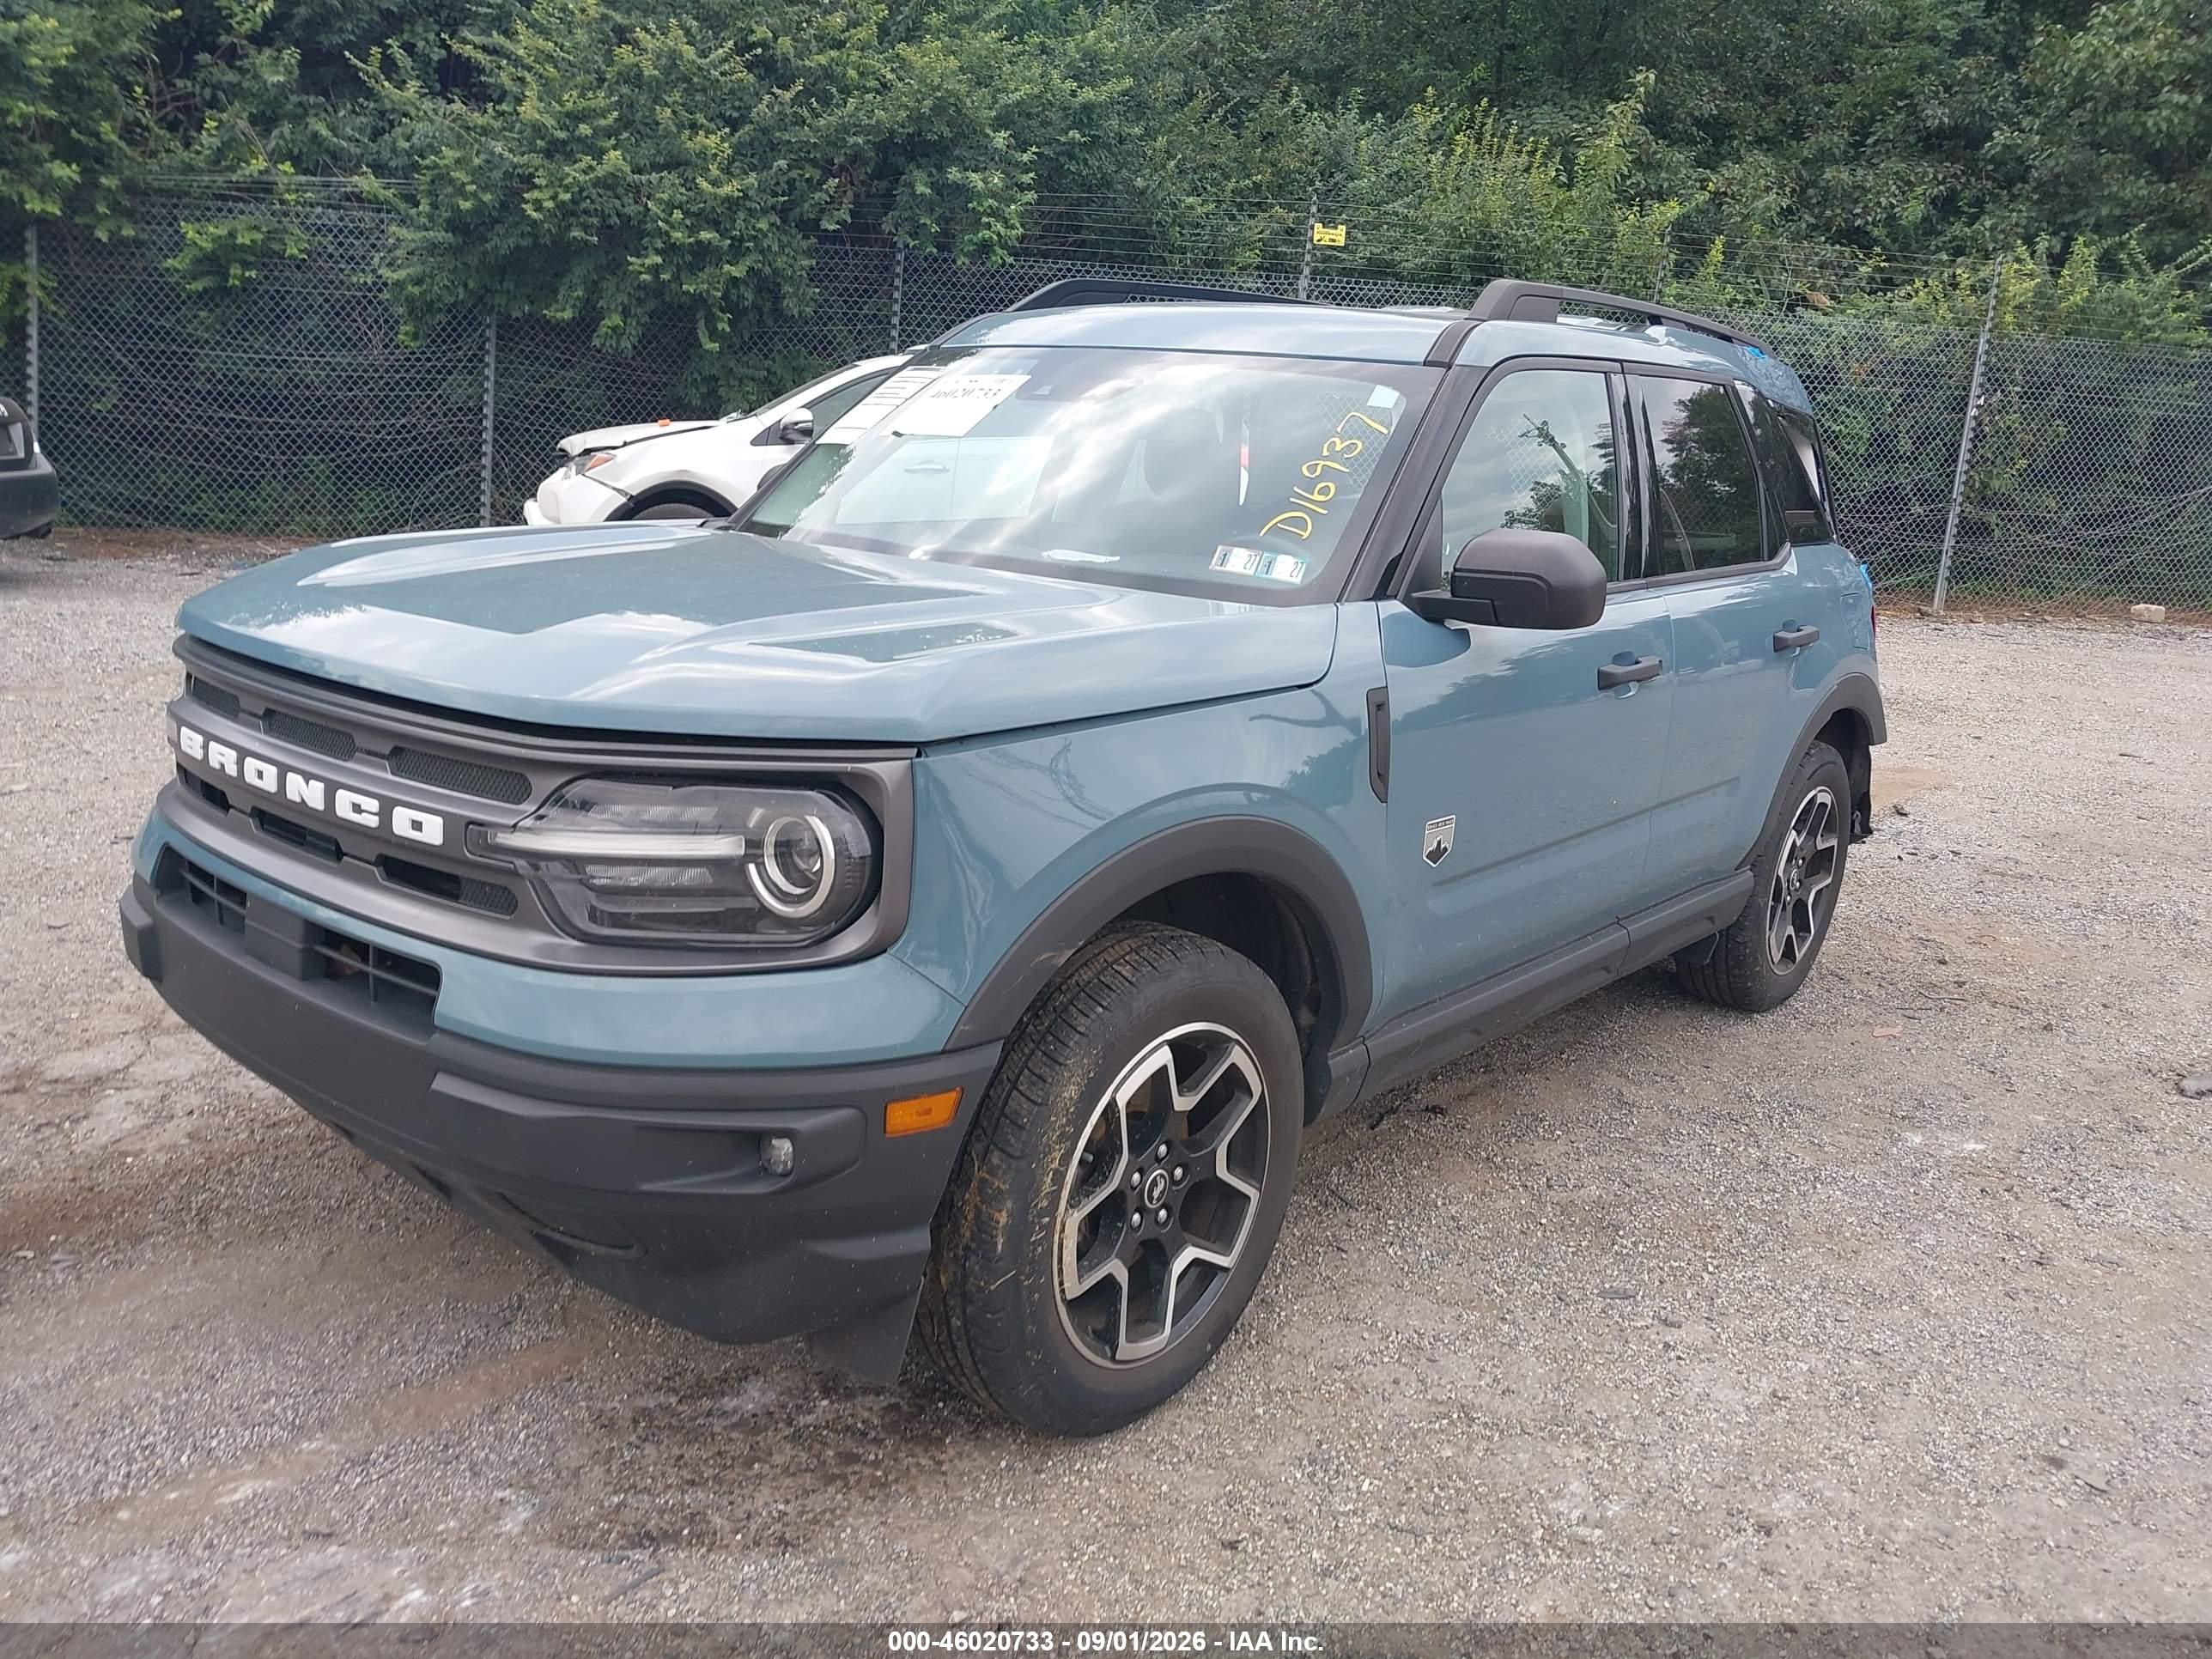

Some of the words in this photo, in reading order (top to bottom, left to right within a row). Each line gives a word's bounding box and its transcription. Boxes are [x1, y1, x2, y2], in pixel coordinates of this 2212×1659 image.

[1259, 411, 1388, 539] D16937
[1243, 553, 1258, 571] 27
[1289, 561, 1304, 578] 27
[179, 726, 444, 846] BRONCO
